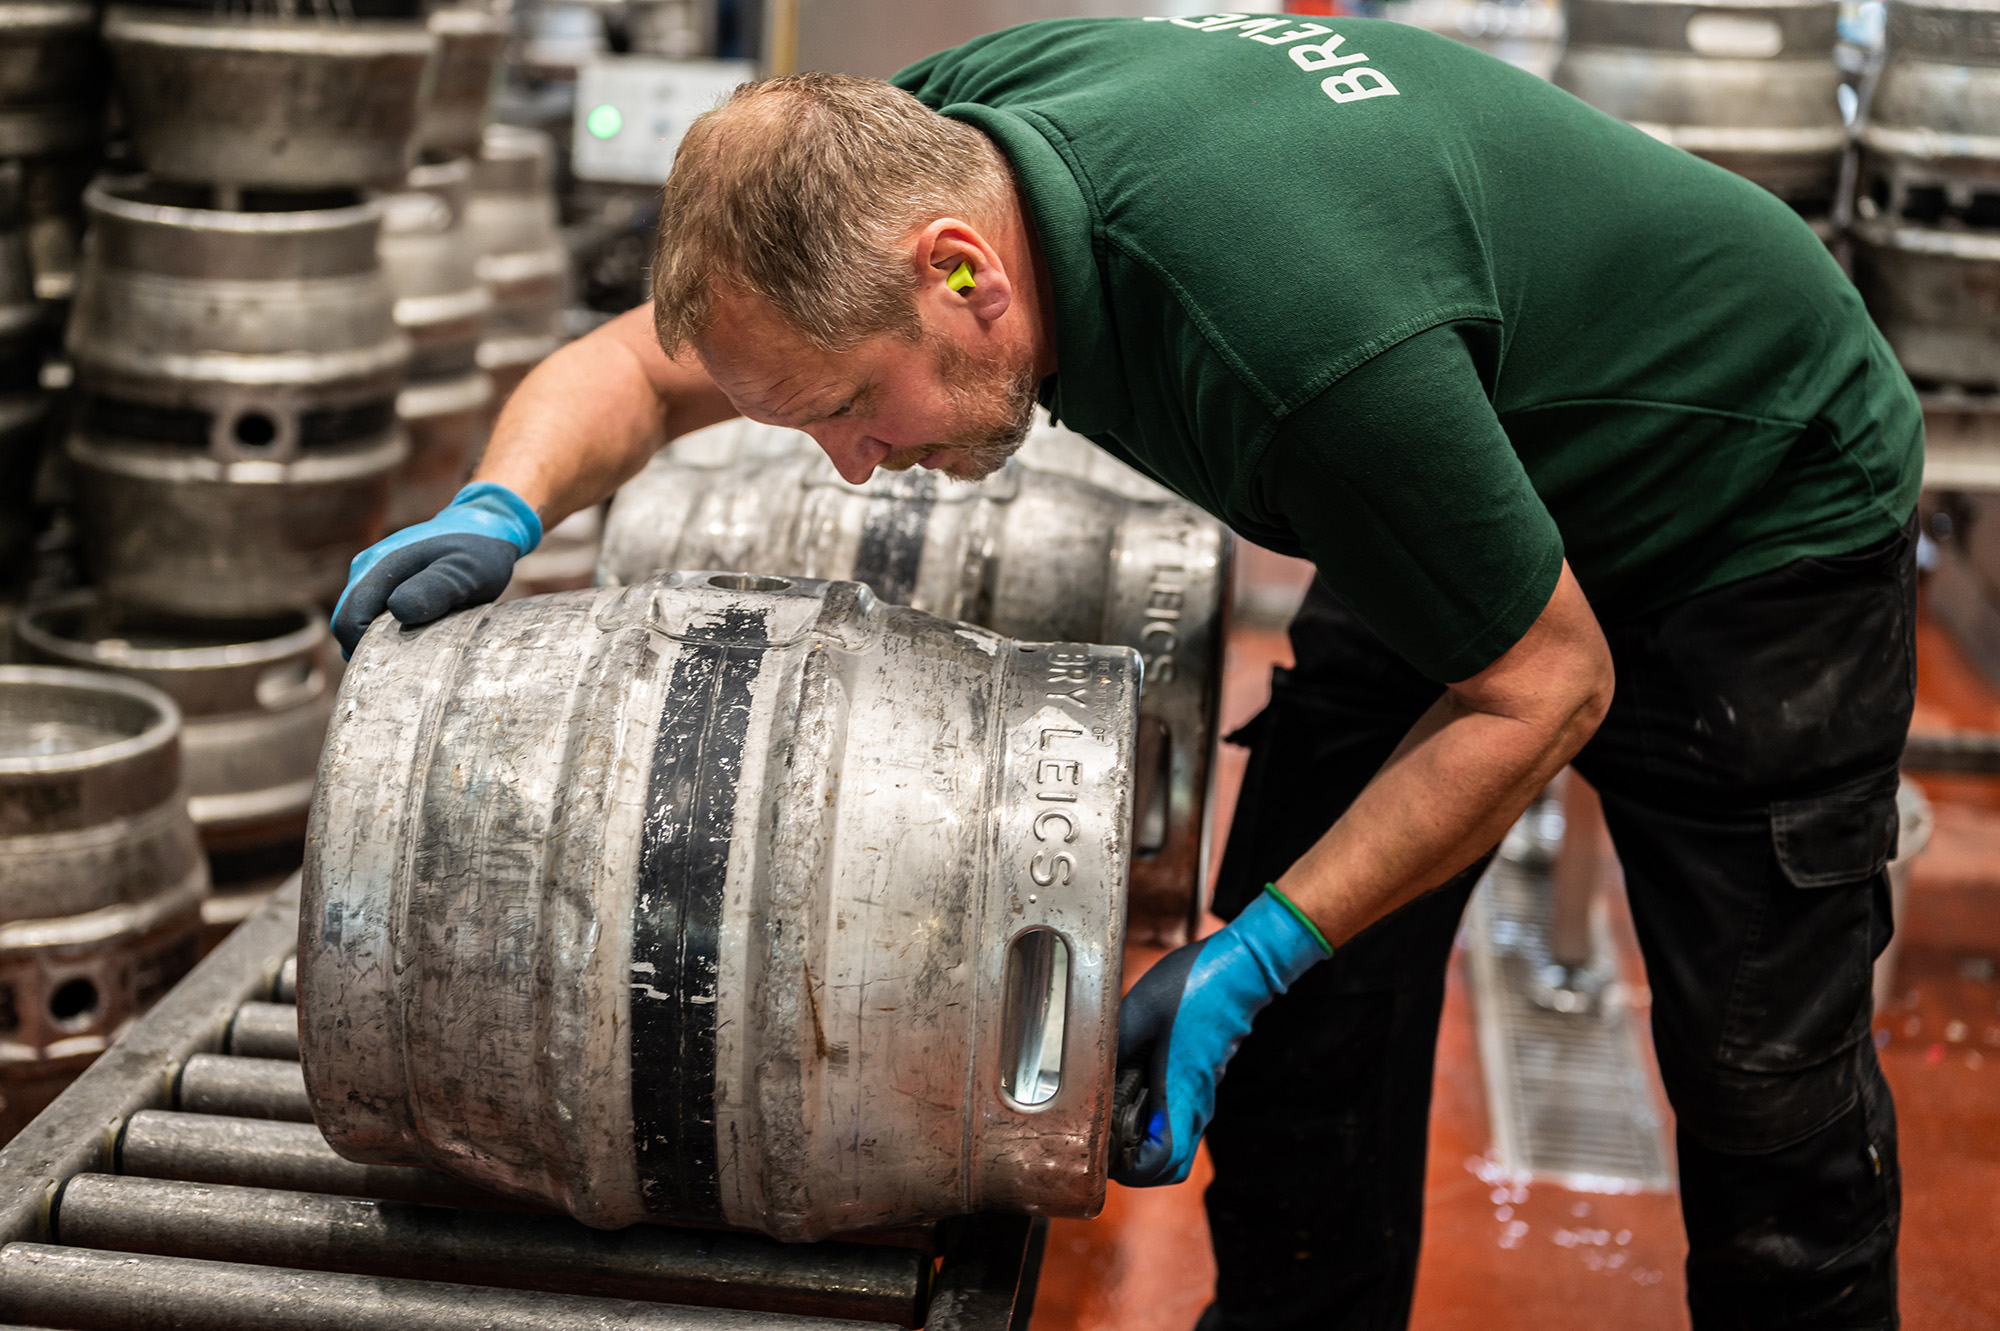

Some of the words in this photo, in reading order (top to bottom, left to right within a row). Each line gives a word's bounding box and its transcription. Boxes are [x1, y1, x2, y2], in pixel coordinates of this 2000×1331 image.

[1142, 12, 1400, 104] BREWE
[1092, 726, 1105, 742] OF
[1029, 728, 1083, 903] LEICS.
